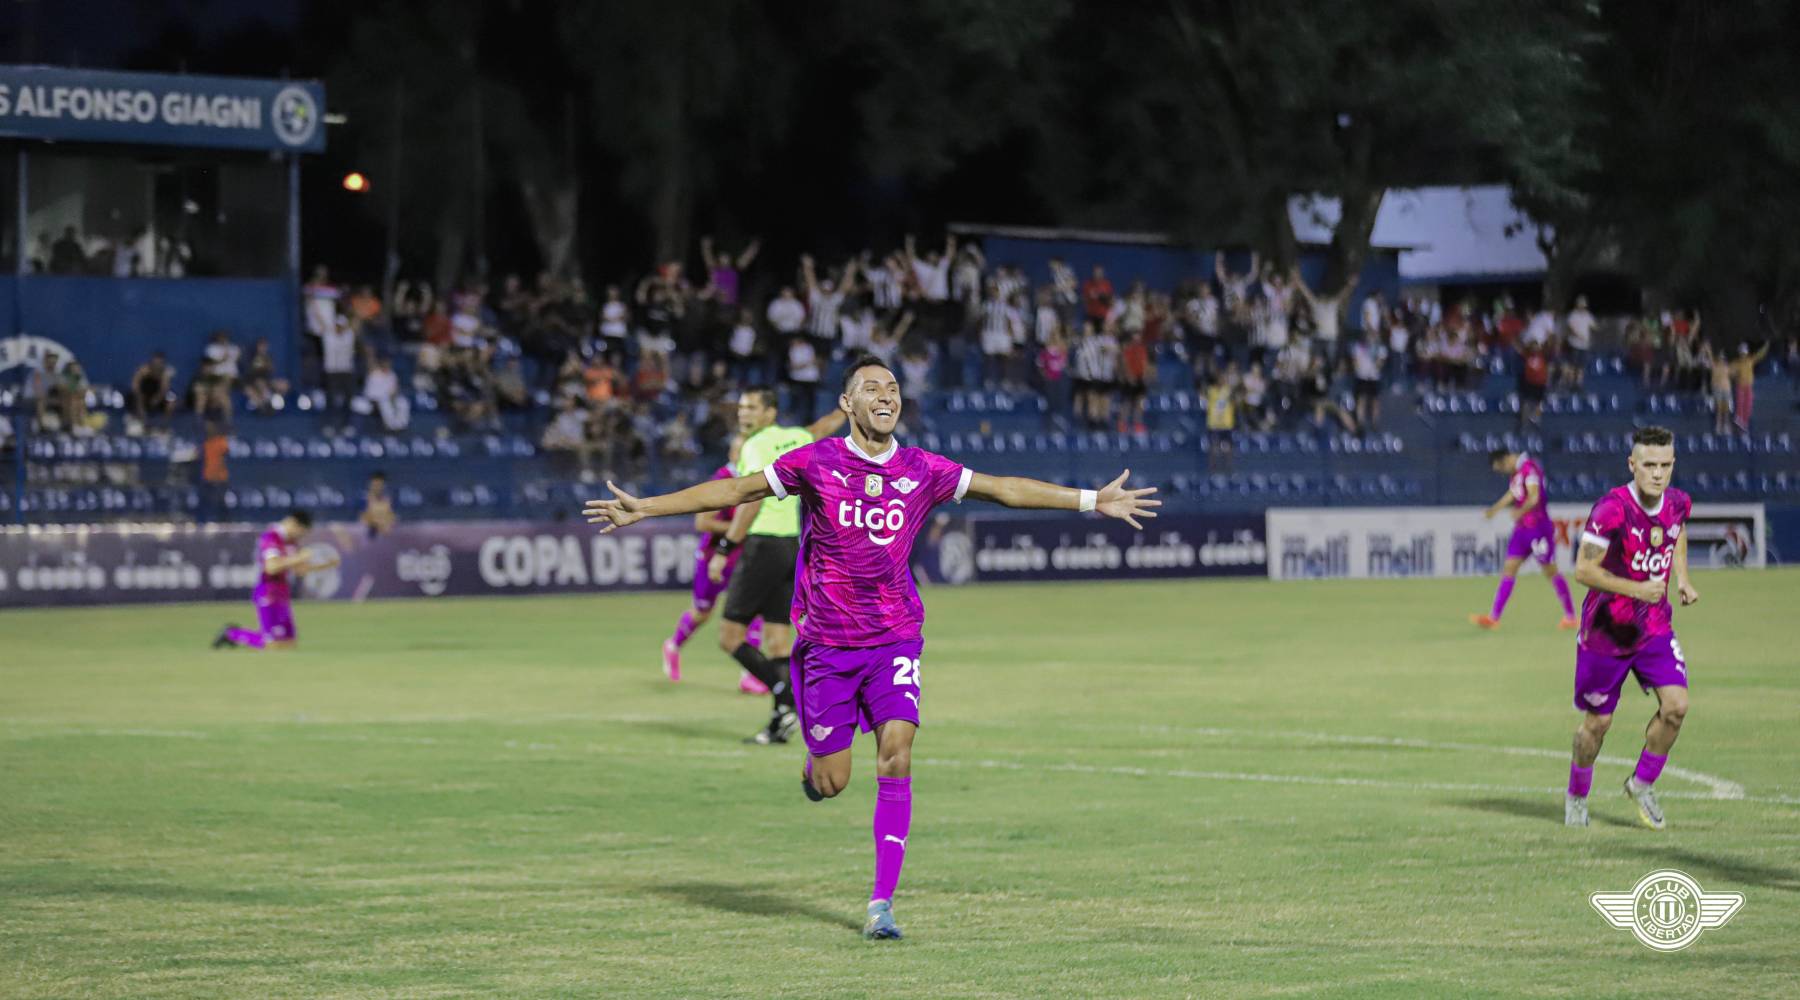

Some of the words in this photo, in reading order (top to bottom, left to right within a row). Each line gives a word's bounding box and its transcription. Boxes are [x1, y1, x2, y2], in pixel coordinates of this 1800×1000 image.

[15, 84, 157, 123] ALFONSO
[161, 91, 261, 128] GIAGNI
[479, 535, 588, 586] COPA
[591, 534, 648, 584] DE
